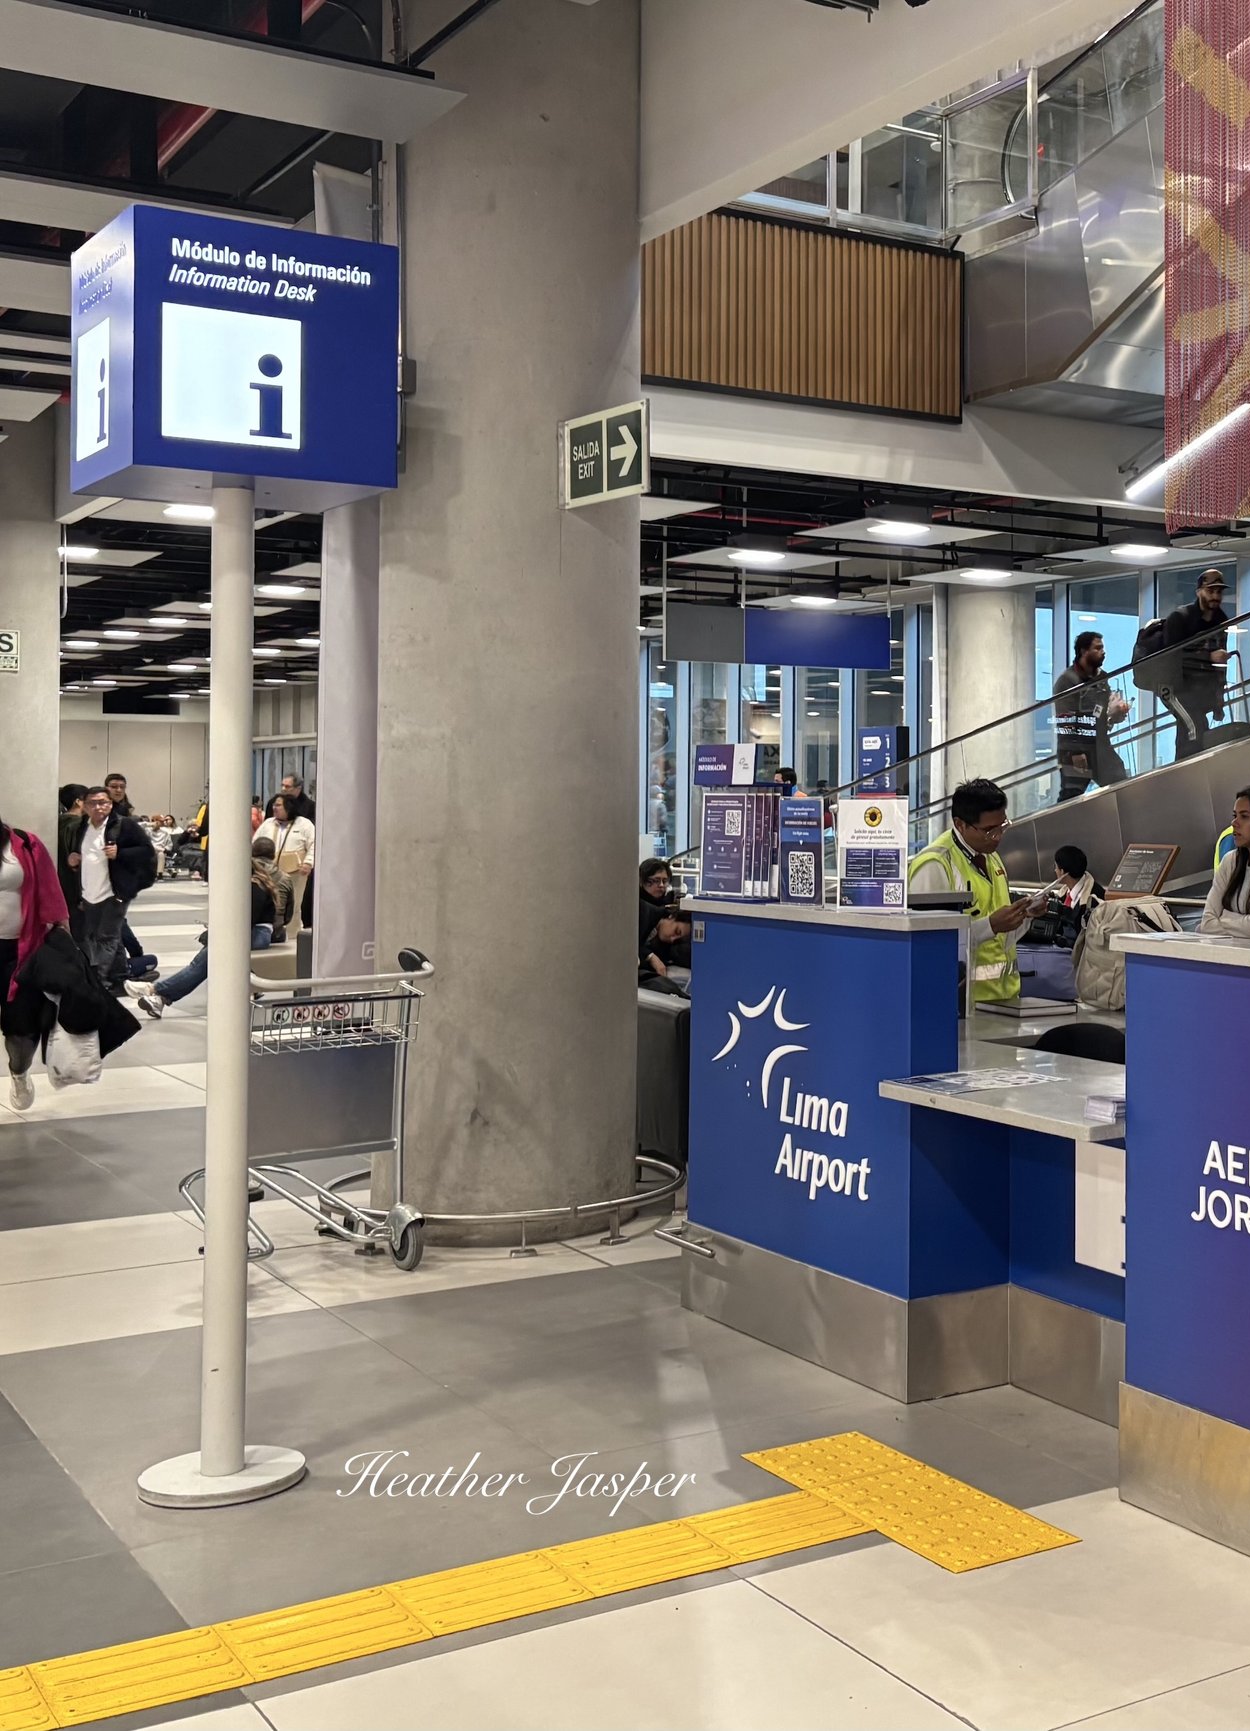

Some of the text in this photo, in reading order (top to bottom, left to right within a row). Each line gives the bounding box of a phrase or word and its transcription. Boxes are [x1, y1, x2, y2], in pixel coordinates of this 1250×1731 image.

[171, 237, 371, 286] Módulo de Información
[168, 264, 317, 302] Information Desk
[573, 440, 600, 462] SALIDA
[578, 461, 595, 480] EXIT
[886, 737, 890, 749] 1
[780, 1077, 848, 1137] Lima
[775, 1133, 871, 1201] Airport
